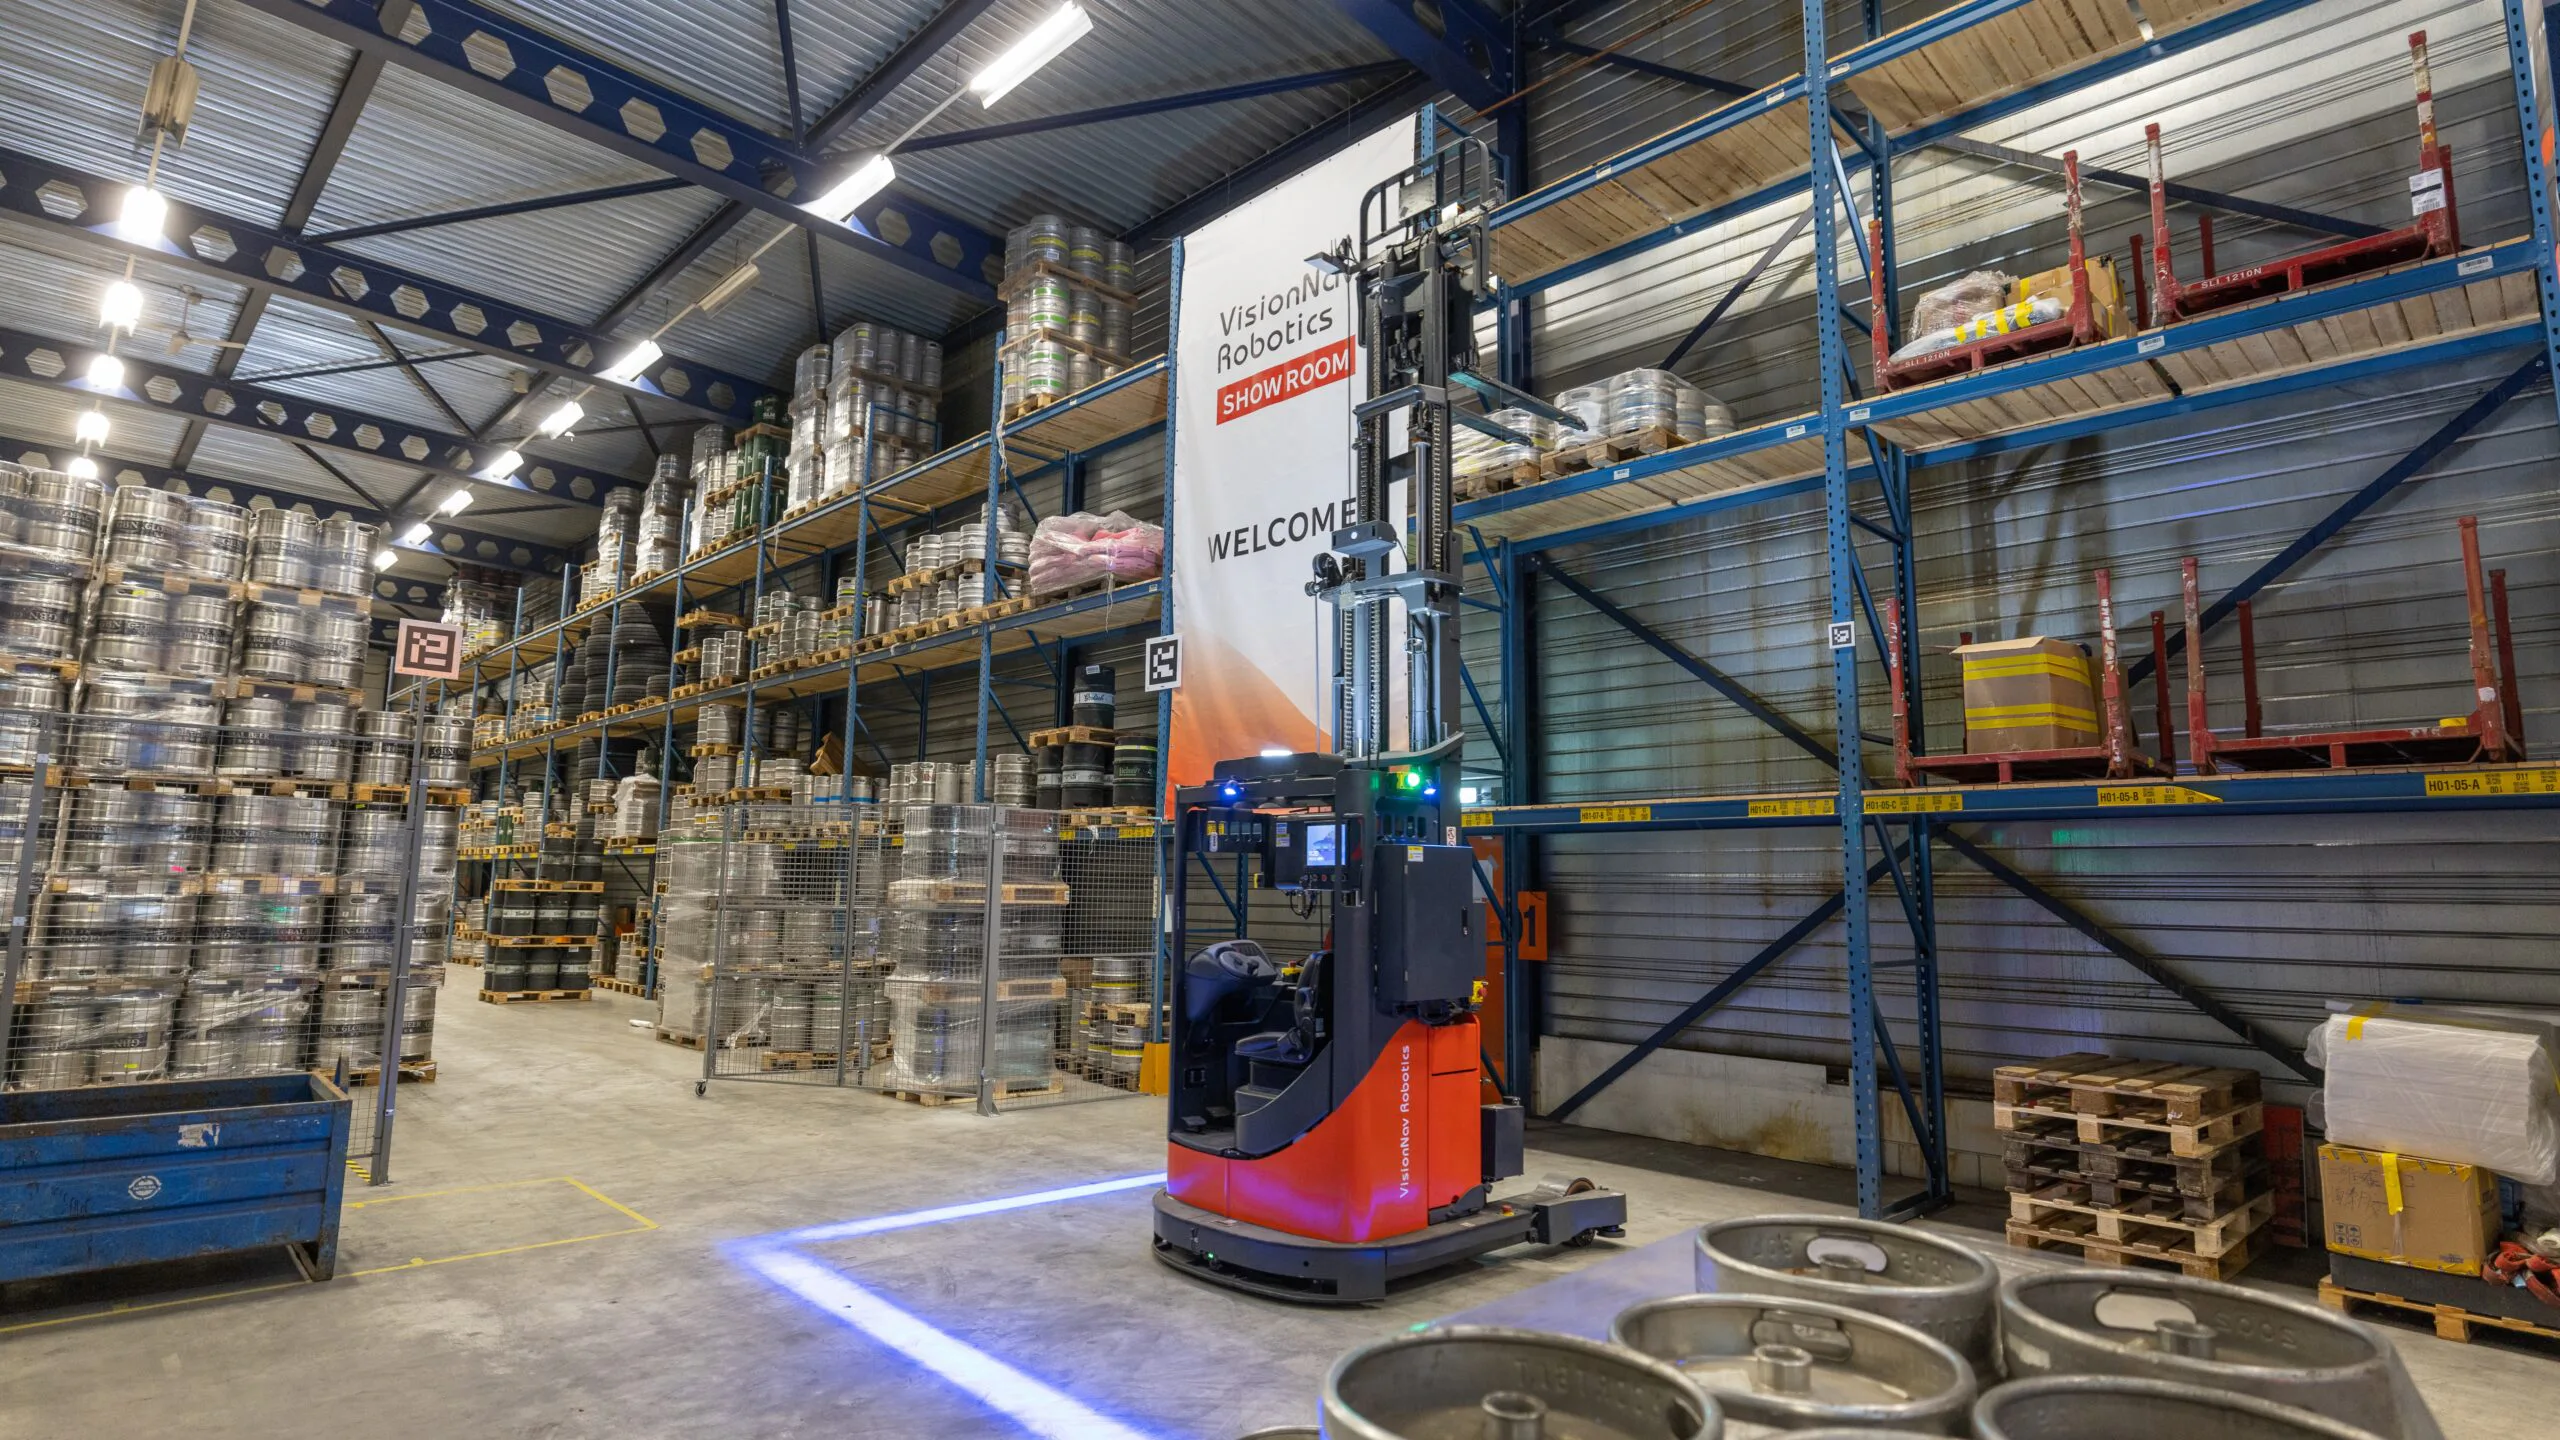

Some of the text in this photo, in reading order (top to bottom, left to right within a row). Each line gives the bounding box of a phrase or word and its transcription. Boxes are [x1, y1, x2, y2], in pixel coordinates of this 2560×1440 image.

[2225, 266, 2263, 283] 1210N
[1217, 306, 1334, 374] Robotics
[1207, 496, 1358, 564] WELCOME
[29, 611, 58, 622] GBN
[433, 746, 456, 756] GBN
[2428, 779, 2481, 792] H01-05-A
[2099, 791, 2140, 803] H01-05-B
[1749, 804, 1778, 814] H01-07-A
[1865, 800, 1898, 810] H01-05-C
[1399, 1045, 1411, 1199] VisionNav Robotics
